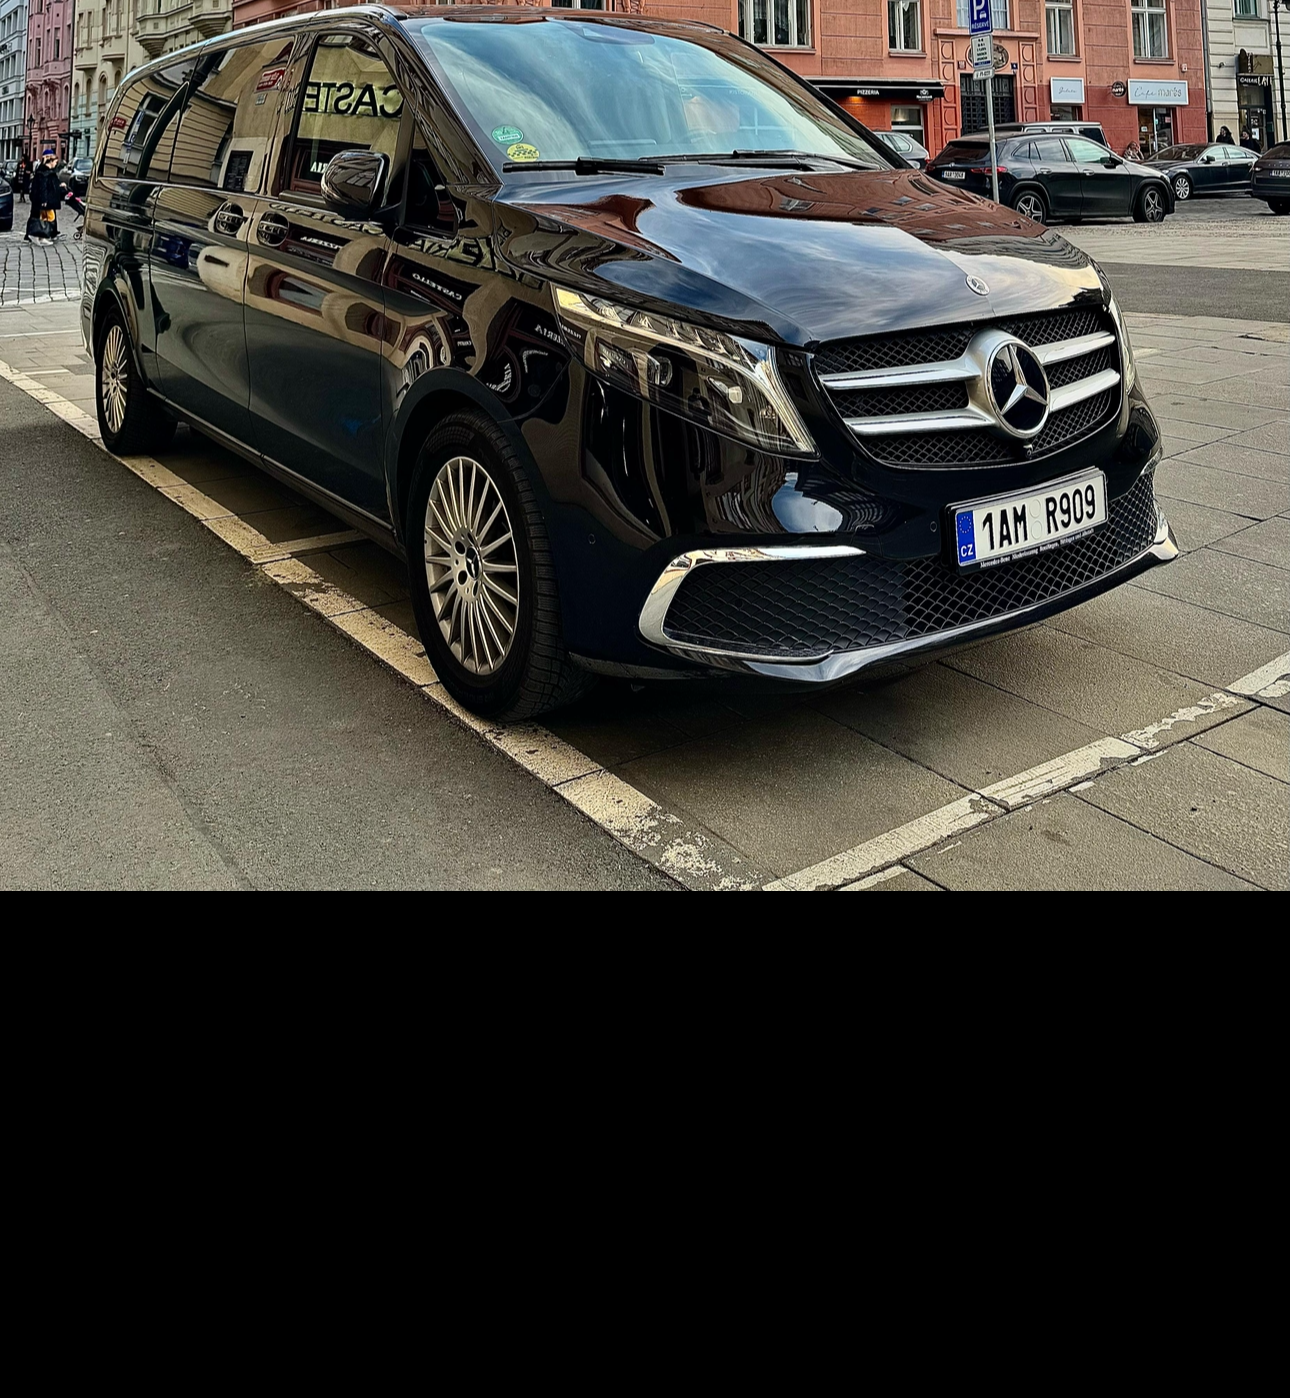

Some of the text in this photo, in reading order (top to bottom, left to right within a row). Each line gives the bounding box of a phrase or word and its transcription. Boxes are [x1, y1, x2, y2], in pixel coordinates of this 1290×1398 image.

[982, 484, 1096, 551] 1AM R909
[961, 544, 974, 557] CZ
[980, 556, 1010, 569] Mercedes-Benz
